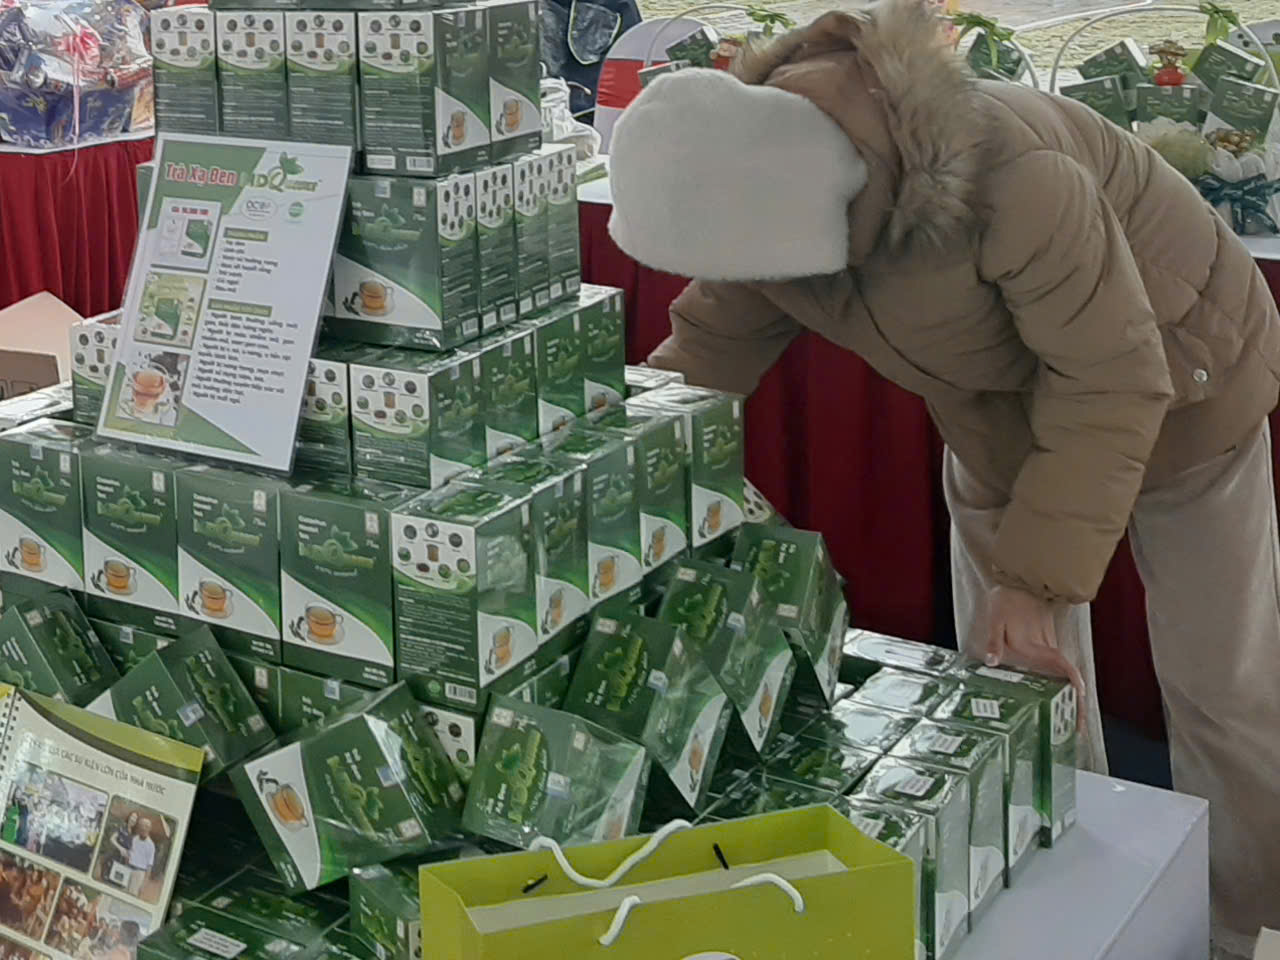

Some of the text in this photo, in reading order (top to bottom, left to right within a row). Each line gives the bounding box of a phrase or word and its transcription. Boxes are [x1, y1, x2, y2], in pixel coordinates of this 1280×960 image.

[165, 162, 238, 186] Trà Xạ Đen
